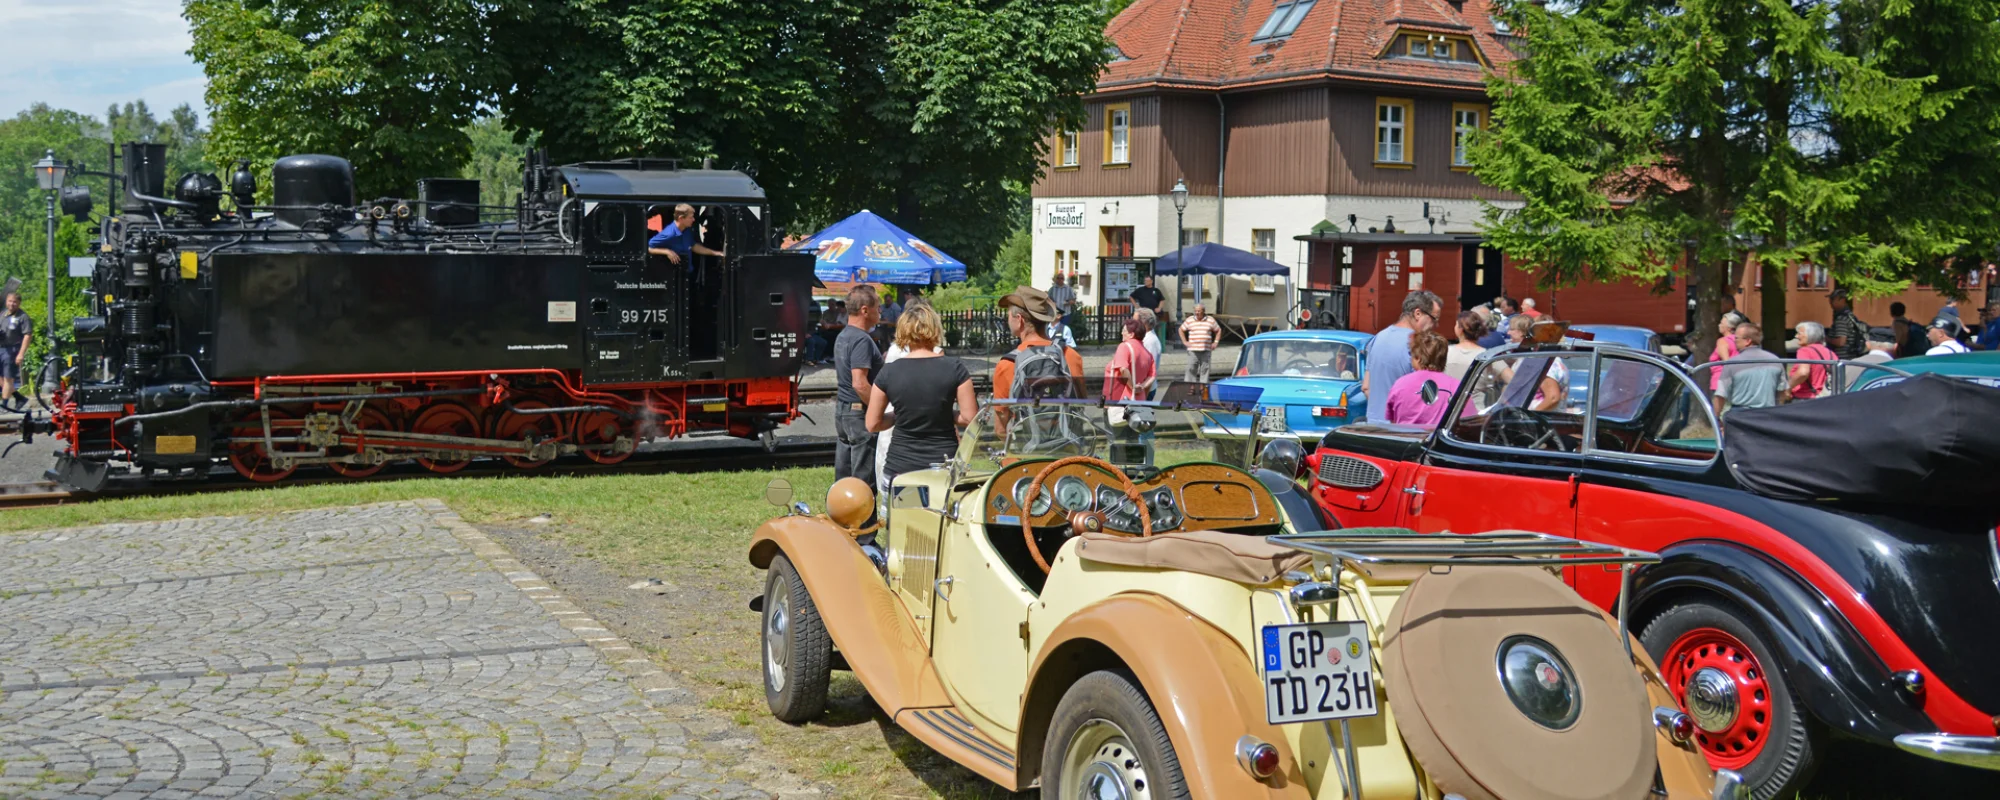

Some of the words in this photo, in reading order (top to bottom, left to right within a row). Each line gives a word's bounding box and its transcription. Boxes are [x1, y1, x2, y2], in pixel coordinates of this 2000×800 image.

[1049, 212, 1083, 227] Jonsdorf
[621, 310, 639, 323] 99
[643, 309, 667, 323] 715
[1266, 408, 1277, 417] ZI
[1289, 630, 1325, 669] GP
[1269, 654, 1277, 666] D
[1270, 676, 1308, 716] TD
[1315, 671, 1373, 713] 23H
